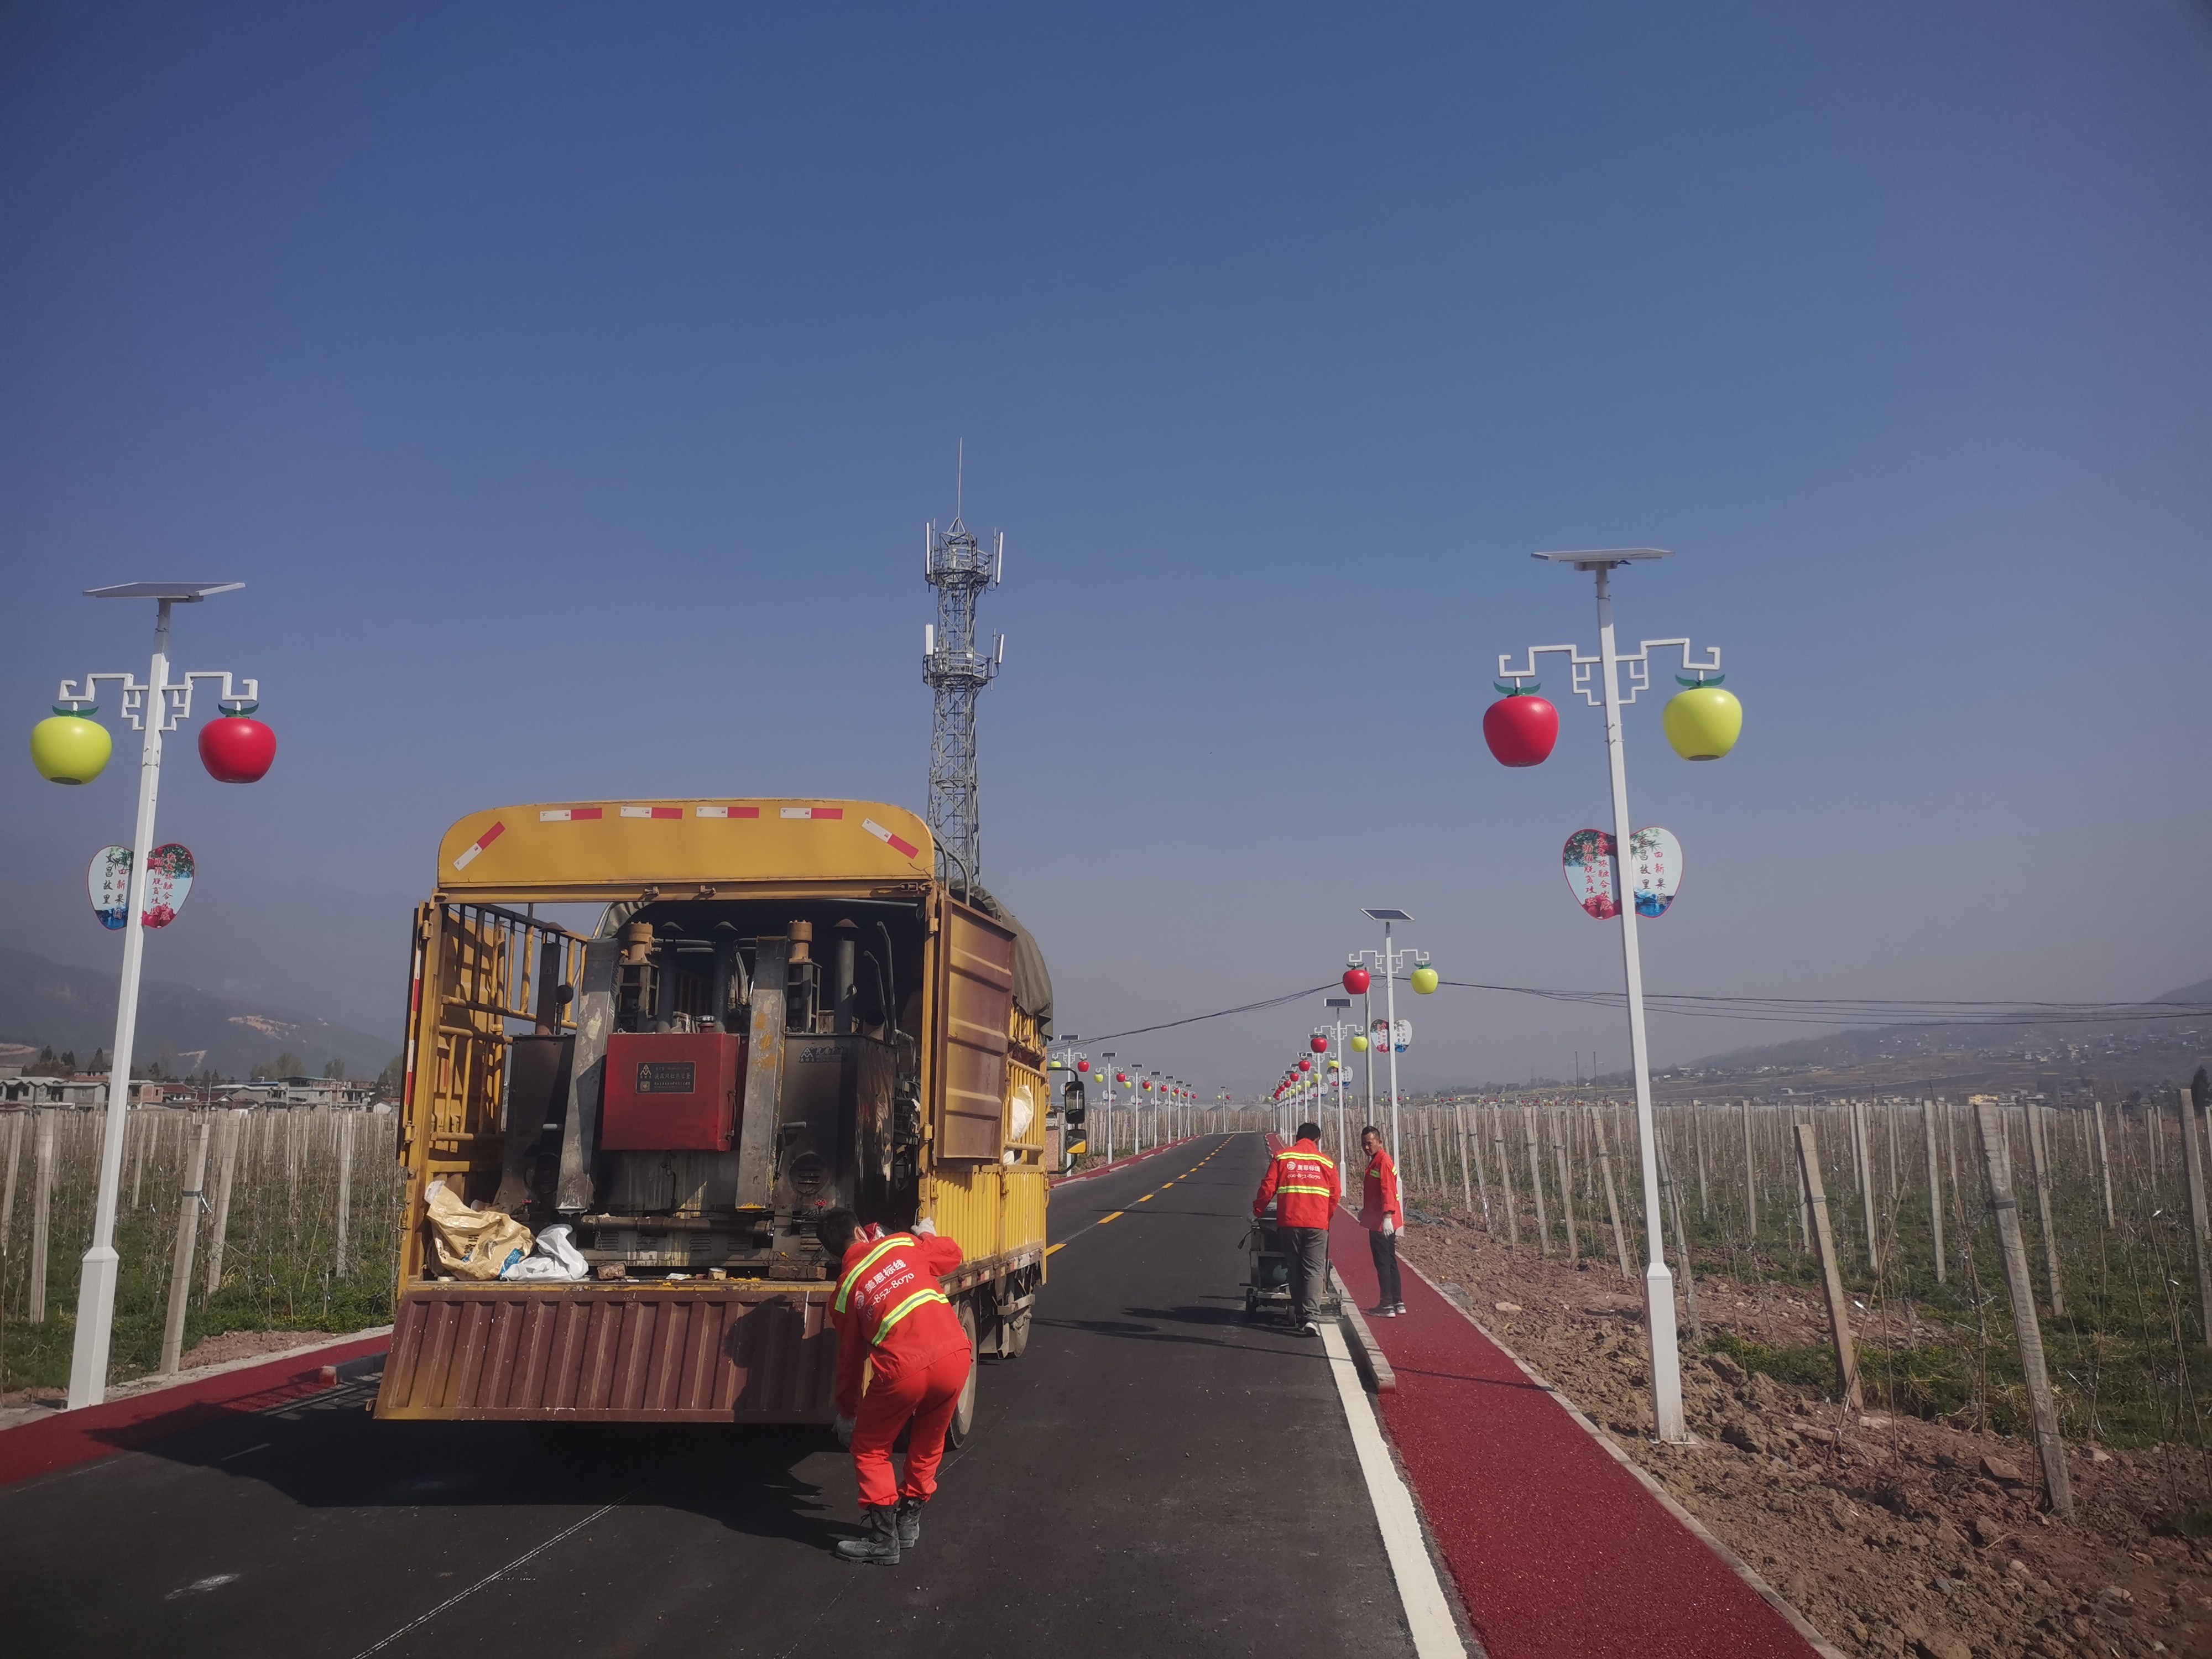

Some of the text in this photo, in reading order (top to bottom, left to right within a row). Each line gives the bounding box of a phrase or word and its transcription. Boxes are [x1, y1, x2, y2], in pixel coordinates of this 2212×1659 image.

[102, 854, 113, 905] 文昌故里
[865, 1259, 906, 1294] 美恩标线
[866, 1272, 914, 1321] 400-852-8070
